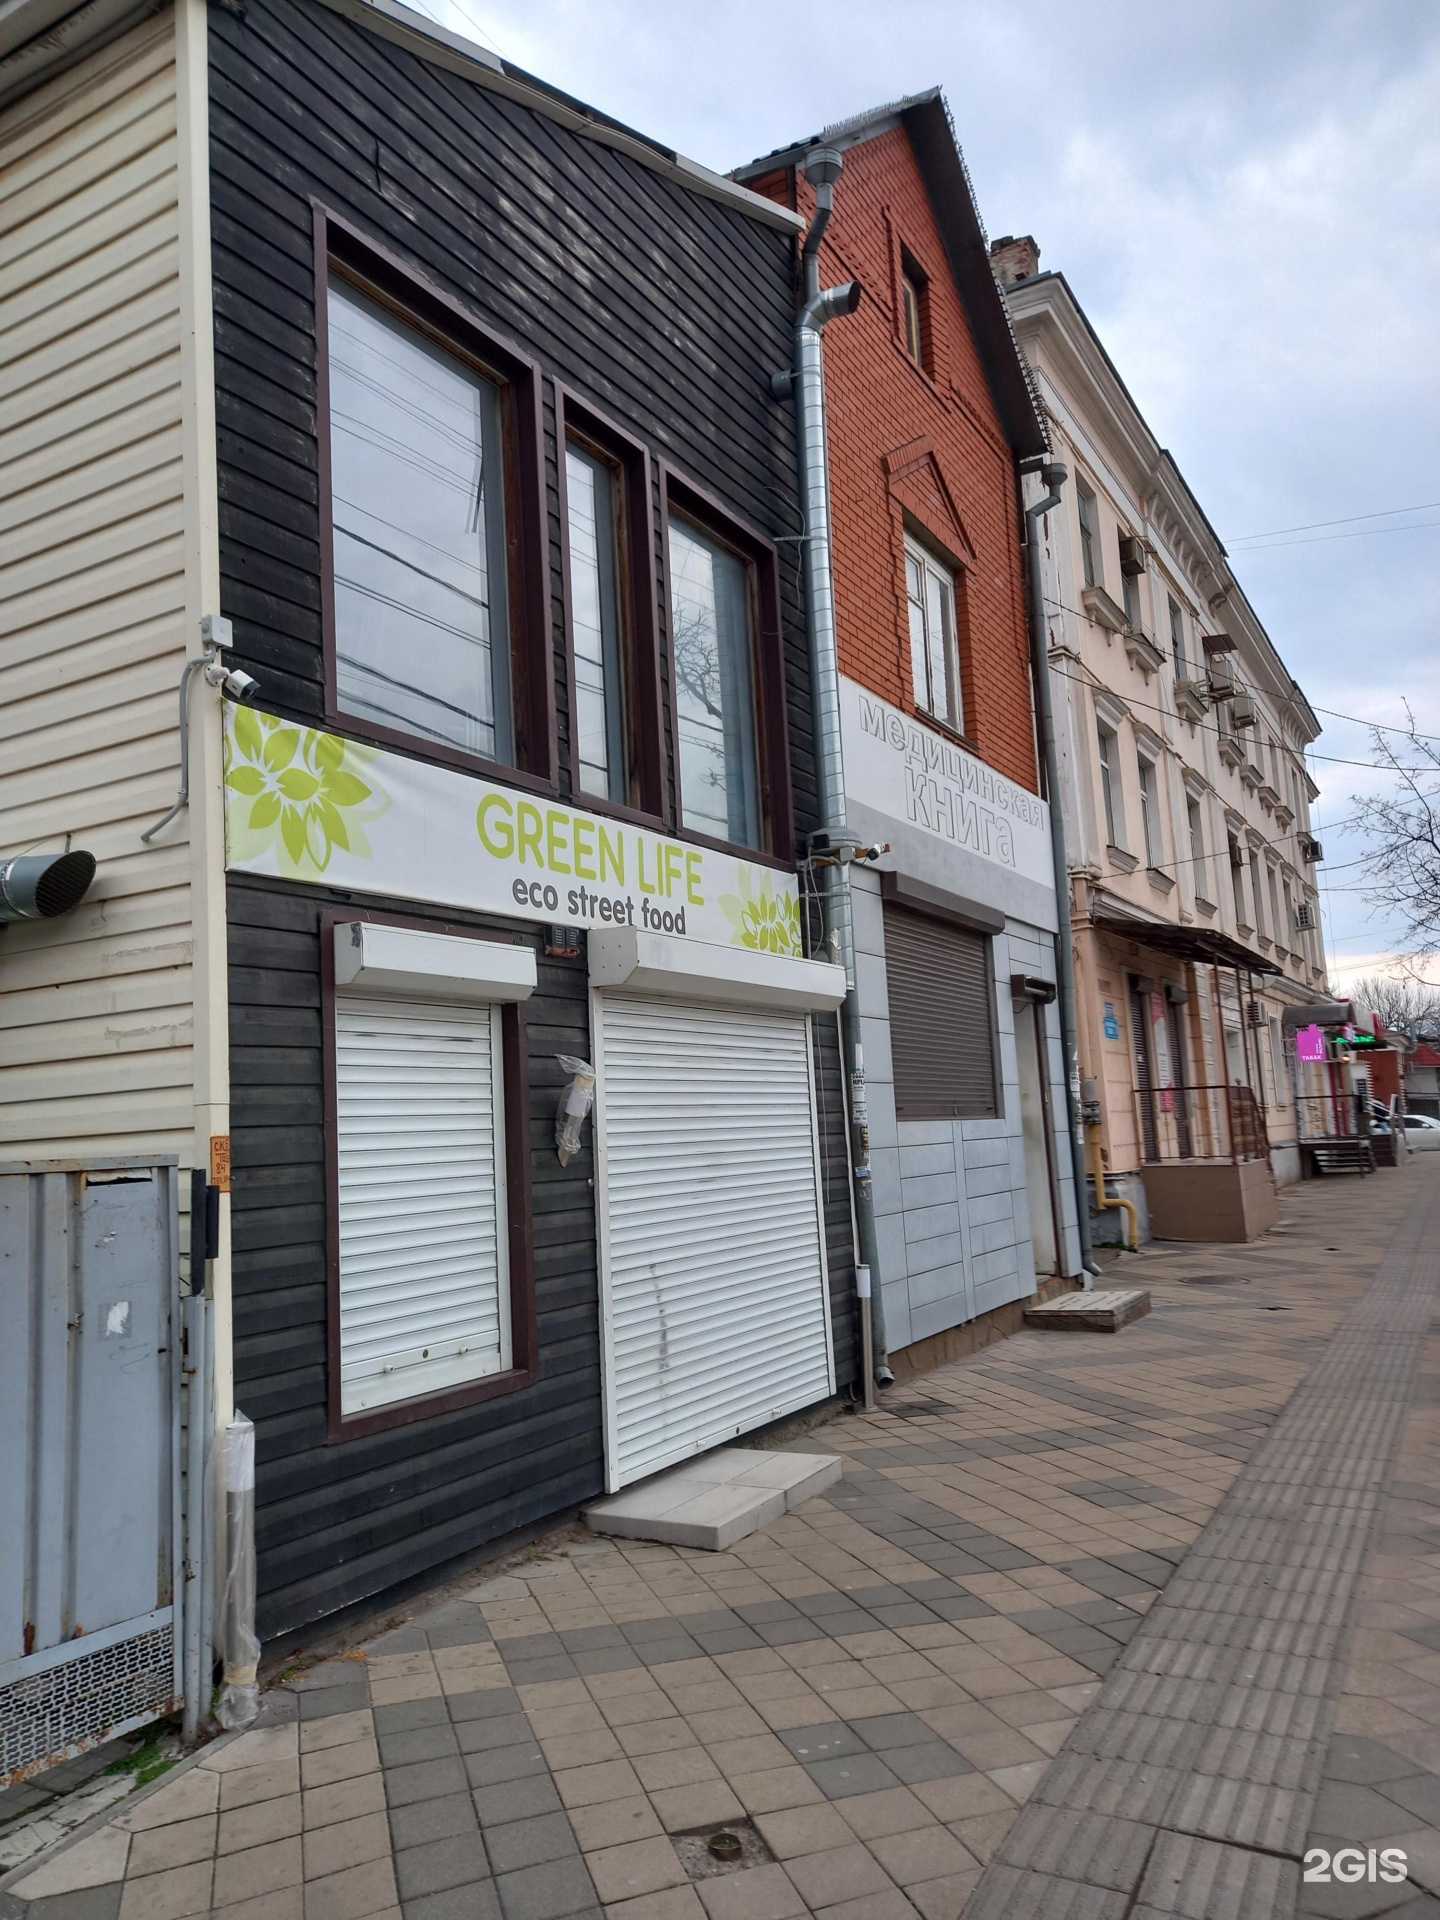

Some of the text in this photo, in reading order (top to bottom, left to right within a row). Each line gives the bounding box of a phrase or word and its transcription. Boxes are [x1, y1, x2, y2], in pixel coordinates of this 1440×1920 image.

[476, 794, 705, 906] GREEN LIFE
[512, 878, 686, 935] eco street food
